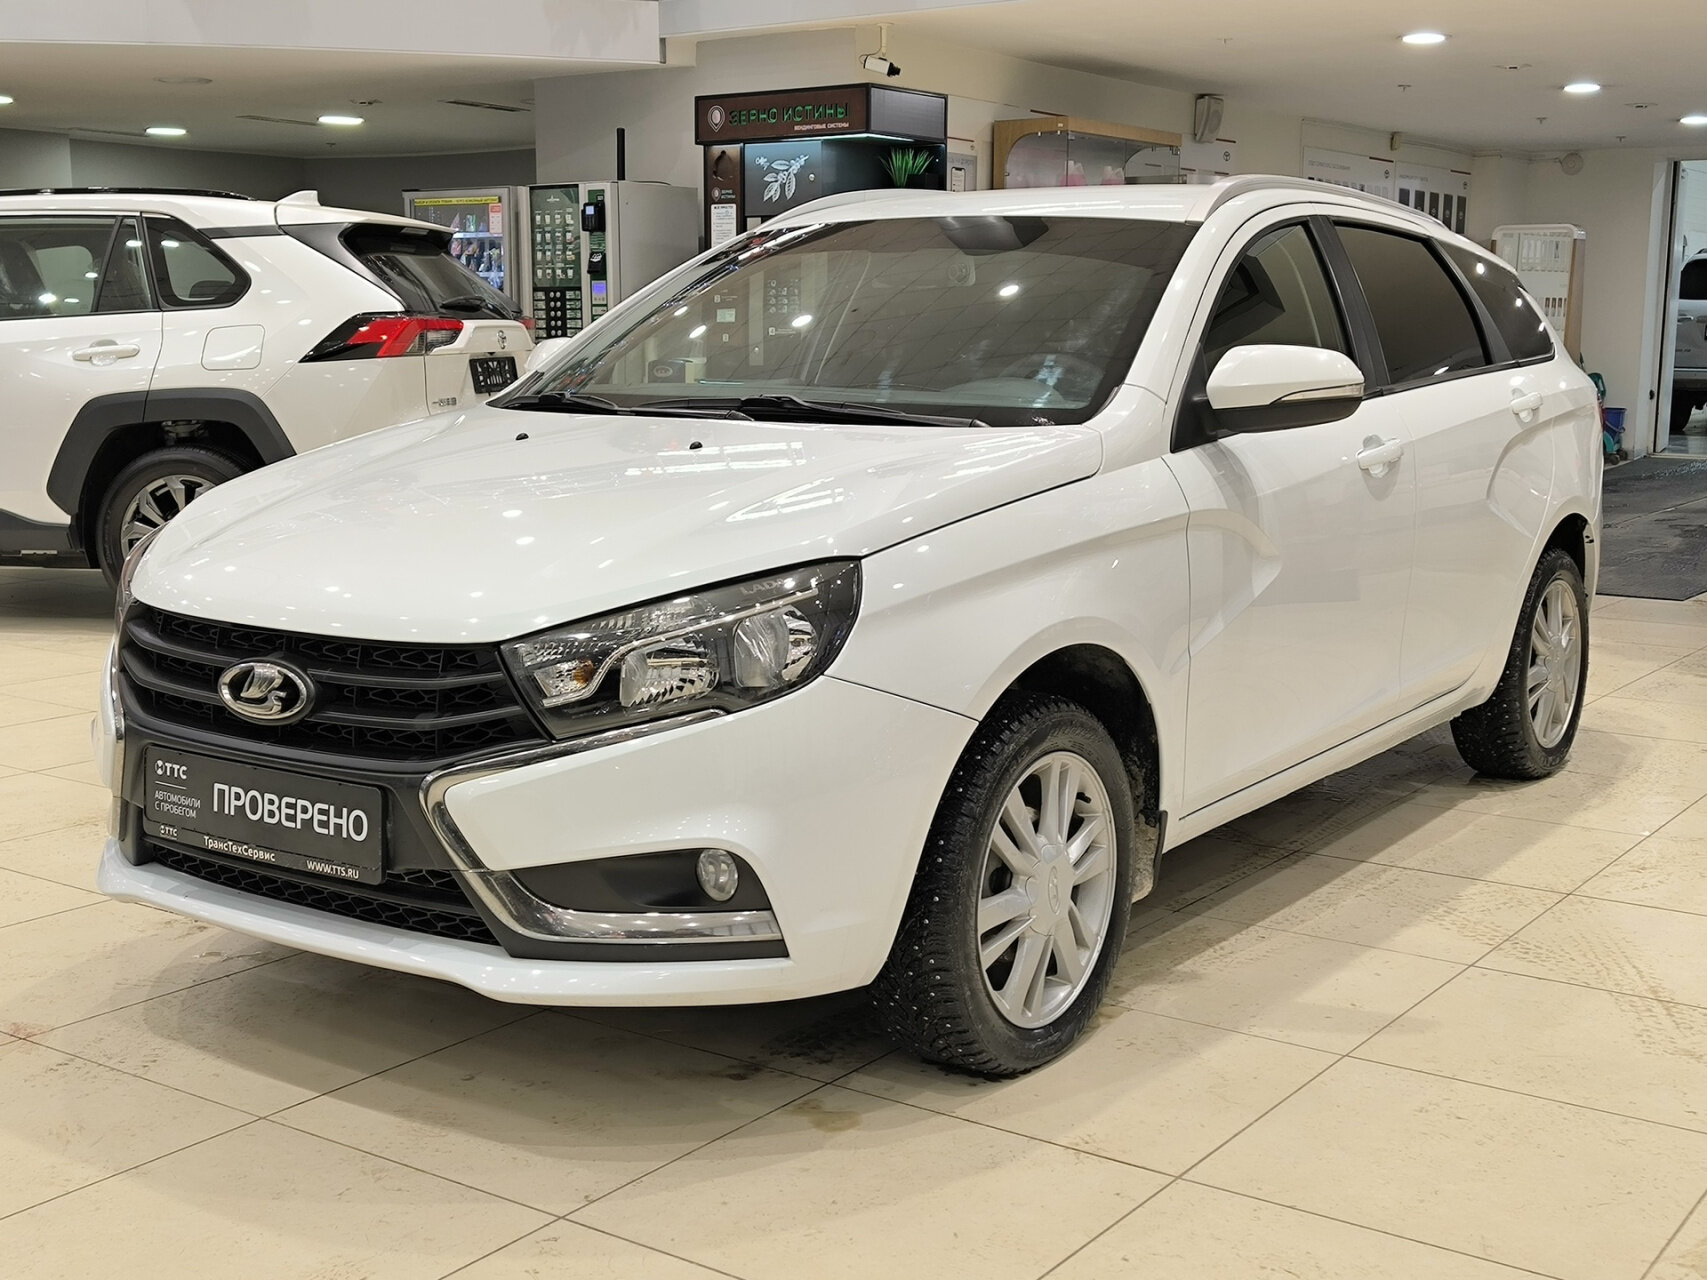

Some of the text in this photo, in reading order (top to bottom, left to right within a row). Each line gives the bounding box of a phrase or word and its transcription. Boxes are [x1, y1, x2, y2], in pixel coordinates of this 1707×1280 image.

[729, 103, 849, 126] ЗЕРНО ИСТИНЫ
[164, 762, 188, 780] ТТС
[154, 790, 201, 809] АВТОМОБИЛИ
[154, 801, 197, 818] С ПРОБЕГОМ
[213, 782, 369, 842] ПРОВЕРЕНО
[203, 835, 276, 862] ТрансТехСервис
[306, 860, 360, 879] WWW.TTS.RU
